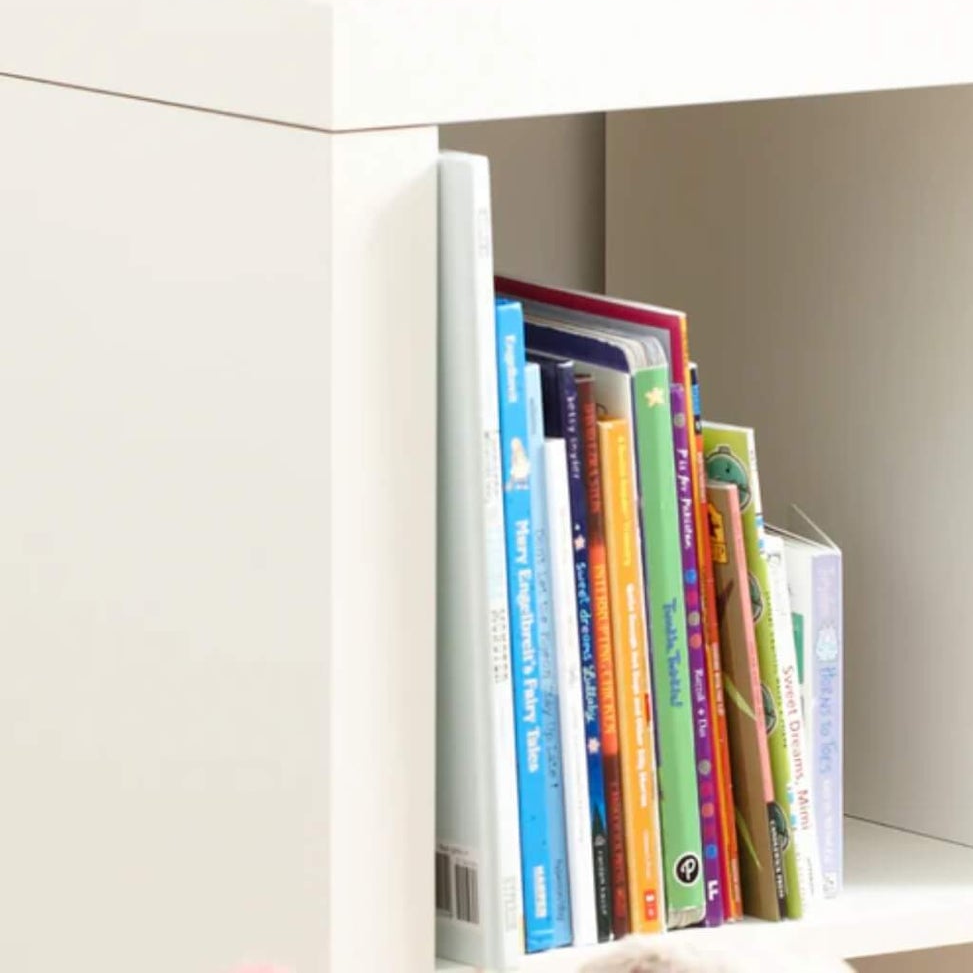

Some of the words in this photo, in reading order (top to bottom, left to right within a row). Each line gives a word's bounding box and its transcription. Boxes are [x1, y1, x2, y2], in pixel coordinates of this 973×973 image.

[677, 449, 689, 458] P
[679, 461, 690, 470] is
[678, 475, 691, 493] for
[515, 520, 530, 564] Mary
[516, 569, 537, 674] Engelbreit's
[523, 678, 538, 723] Fairy
[782, 665, 798, 715] Sweet
[526, 726, 541, 773] Tales
[789, 720, 805, 786] Dreams,
[797, 789, 812, 830] Mimi
